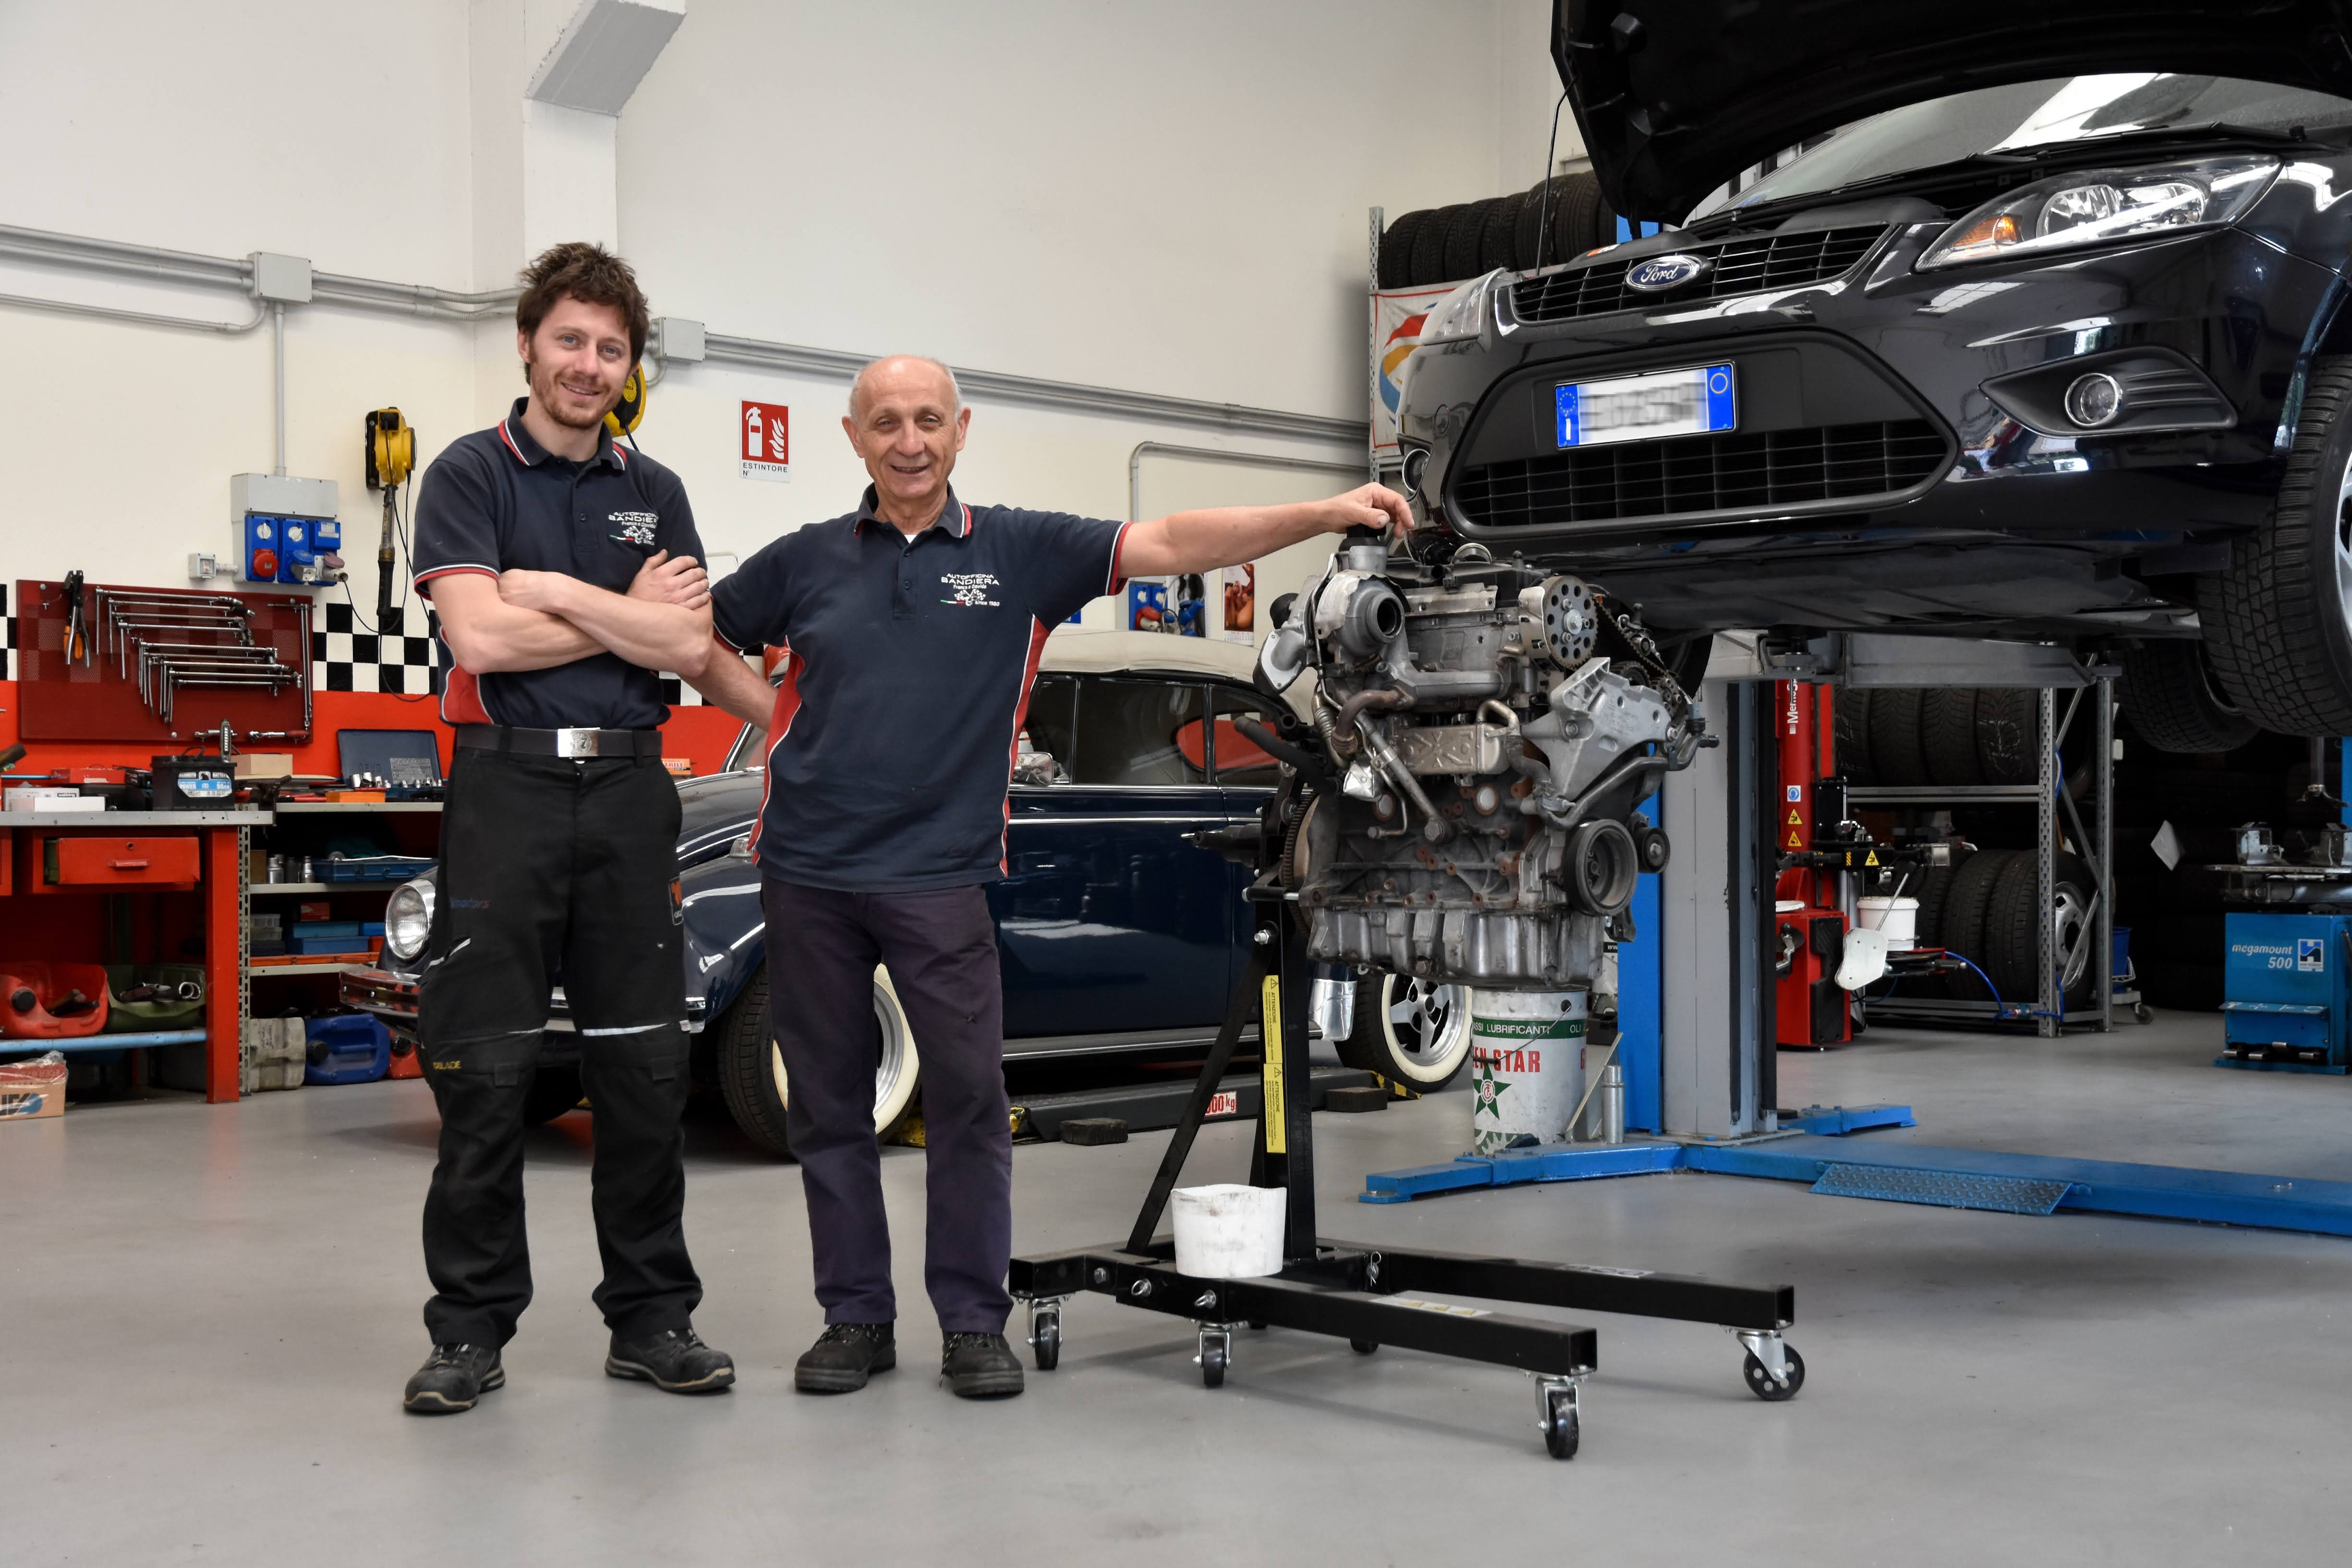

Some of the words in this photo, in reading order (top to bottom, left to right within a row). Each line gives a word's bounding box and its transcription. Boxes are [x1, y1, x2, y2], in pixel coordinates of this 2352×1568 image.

[1640, 262, 1679, 282] Ford
[743, 462, 788, 473] ESTINTORE
[941, 577, 999, 585] BANDIERA
[2232, 944, 2292, 956] megamount
[2267, 957, 2293, 969] 500
[1472, 1021, 1483, 1032] ASSI
[1487, 1024, 1550, 1034] LUBRIFICANTI
[1493, 1049, 1540, 1073] STAR
[1226, 1094, 1235, 1110] kg
